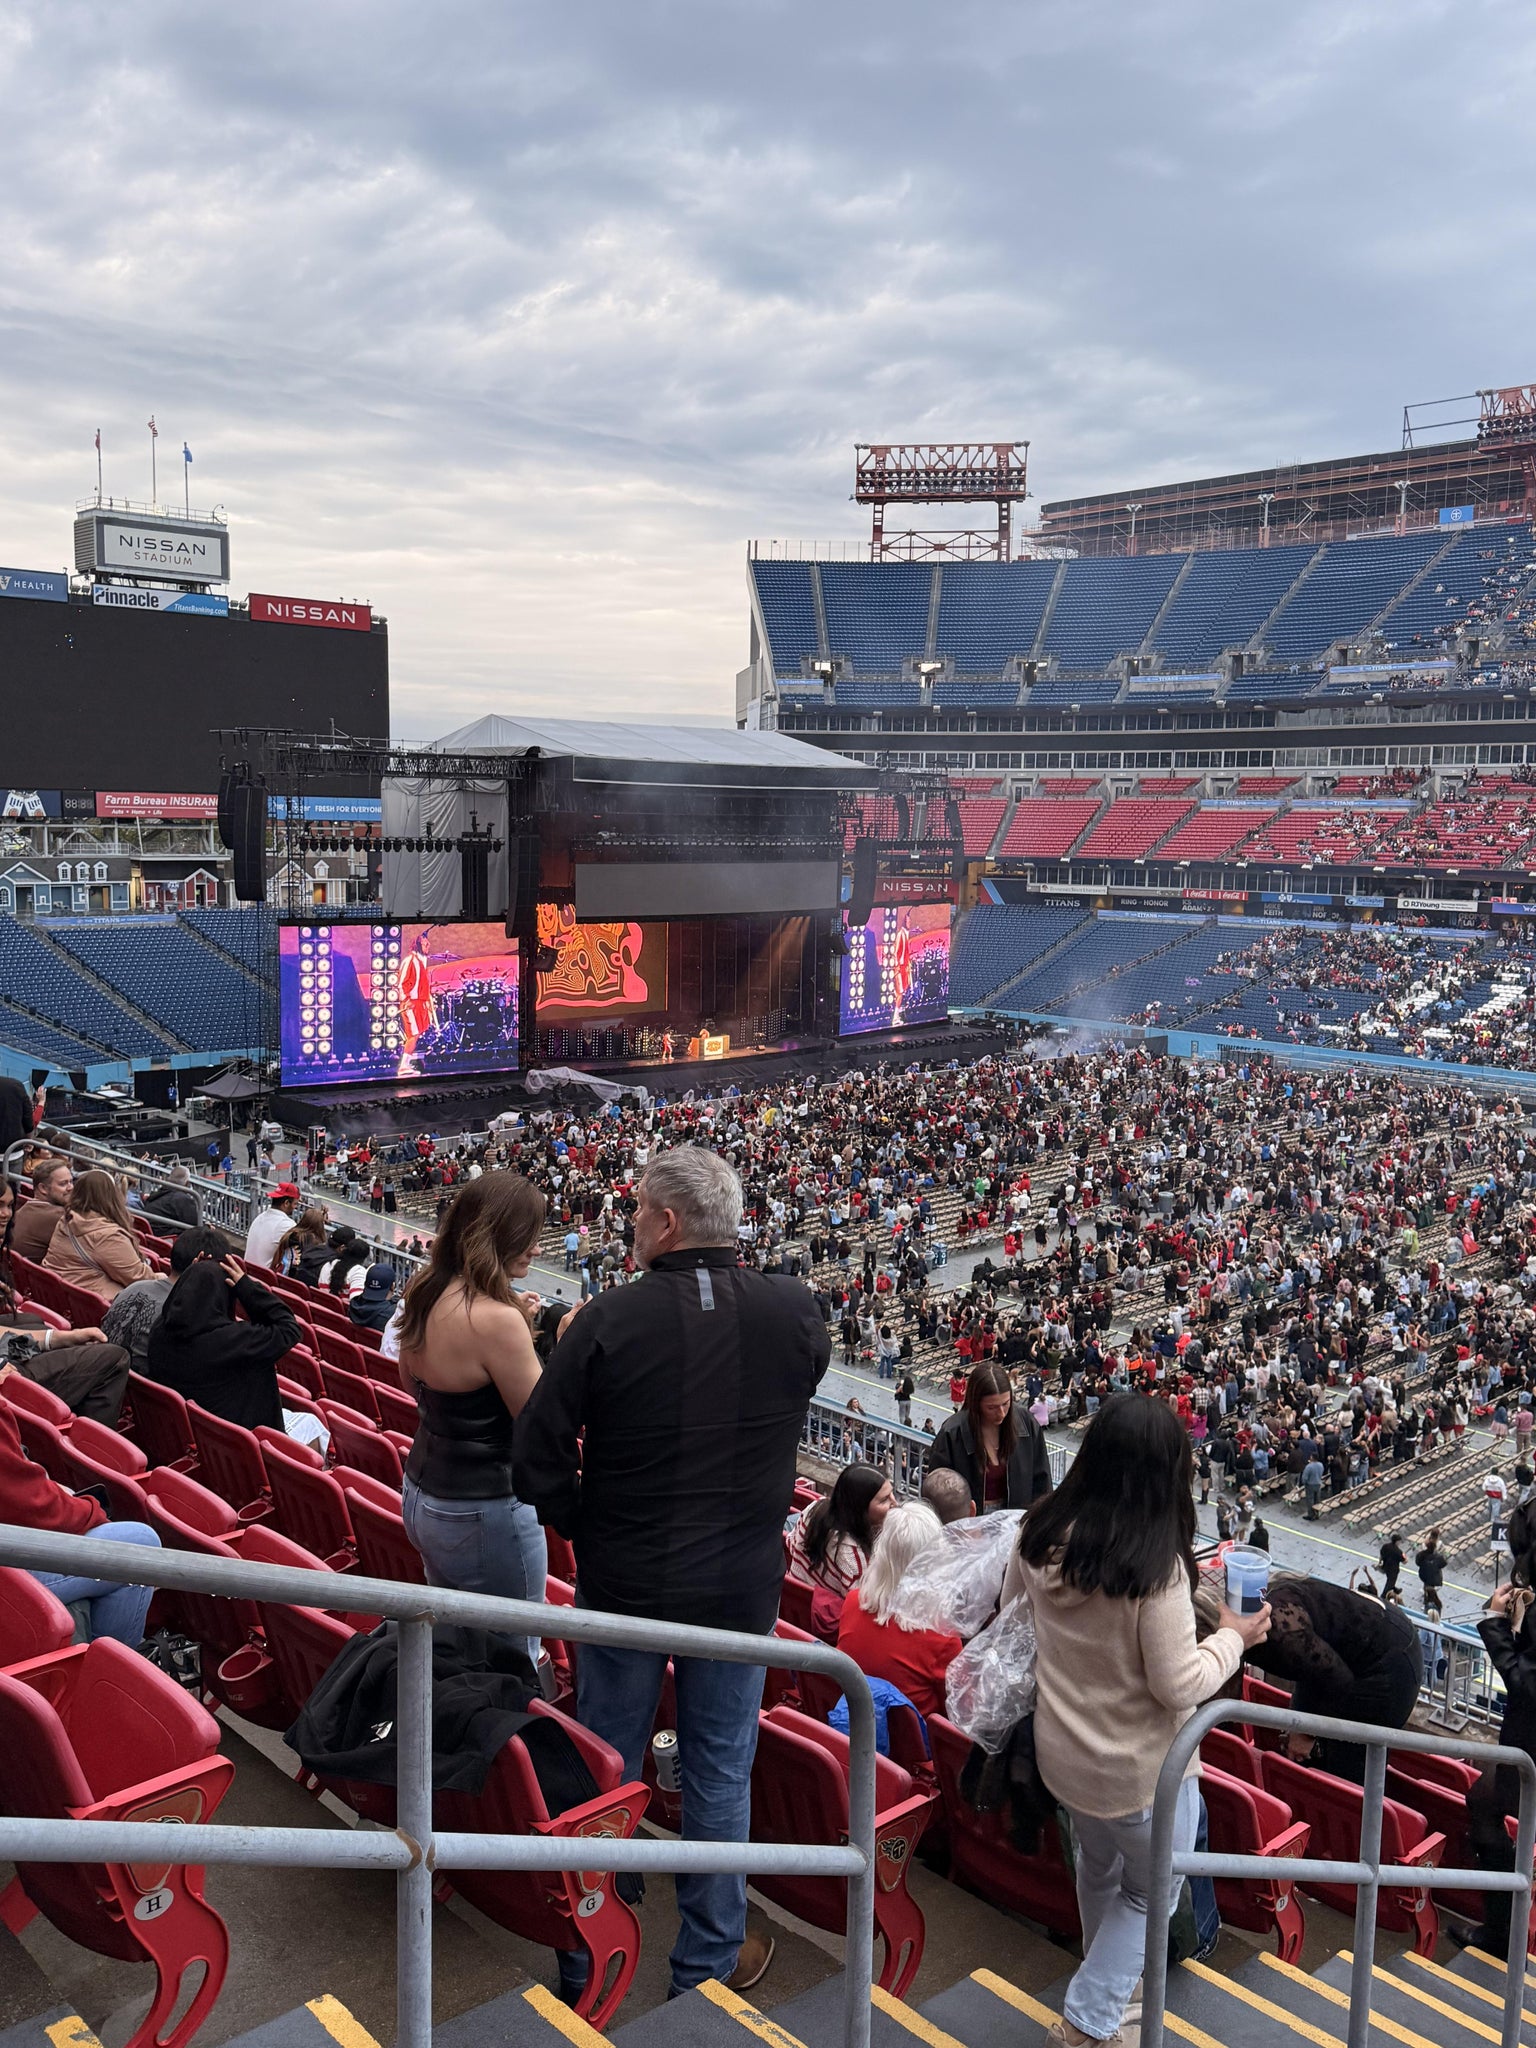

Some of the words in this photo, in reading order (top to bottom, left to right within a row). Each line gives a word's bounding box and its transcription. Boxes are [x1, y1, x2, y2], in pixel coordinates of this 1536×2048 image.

[119, 534, 206, 556] NISSAN
[134, 551, 193, 566] STADIUM
[13, 580, 54, 591] HEALTH
[95, 587, 160, 608] Pinnacle
[174, 603, 228, 616] TitansBanking.com
[267, 602, 356, 624] NISSAN
[105, 795, 130, 805] Farm
[133, 796, 167, 806] Bureau
[315, 805, 335, 813] FRESH
[882, 882, 948, 893] NISSAN
[1044, 899, 1081, 907] TITANS
[1498, 1528, 1508, 1540] K
[145, 1894, 162, 1915] H
[586, 1896, 596, 1911] G
